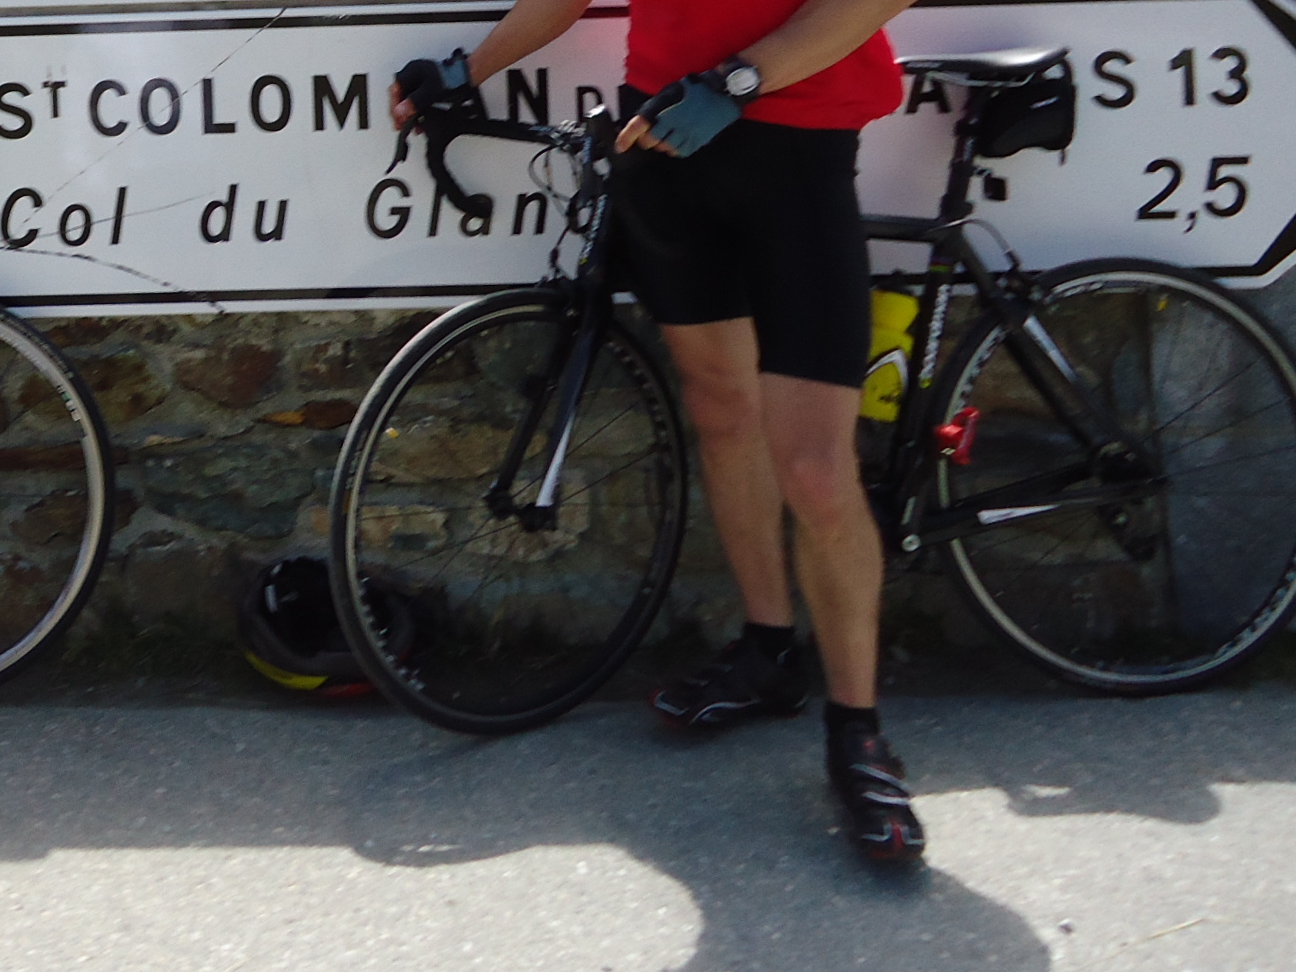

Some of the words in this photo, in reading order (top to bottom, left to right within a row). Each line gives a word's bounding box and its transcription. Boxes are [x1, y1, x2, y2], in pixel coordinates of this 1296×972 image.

[89, 69, 549, 137] COLOMN
[1168, 46, 1250, 107] 13
[0, 186, 127, 248] Col
[200, 183, 288, 244] du
[1136, 155, 1250, 233] 2,5
